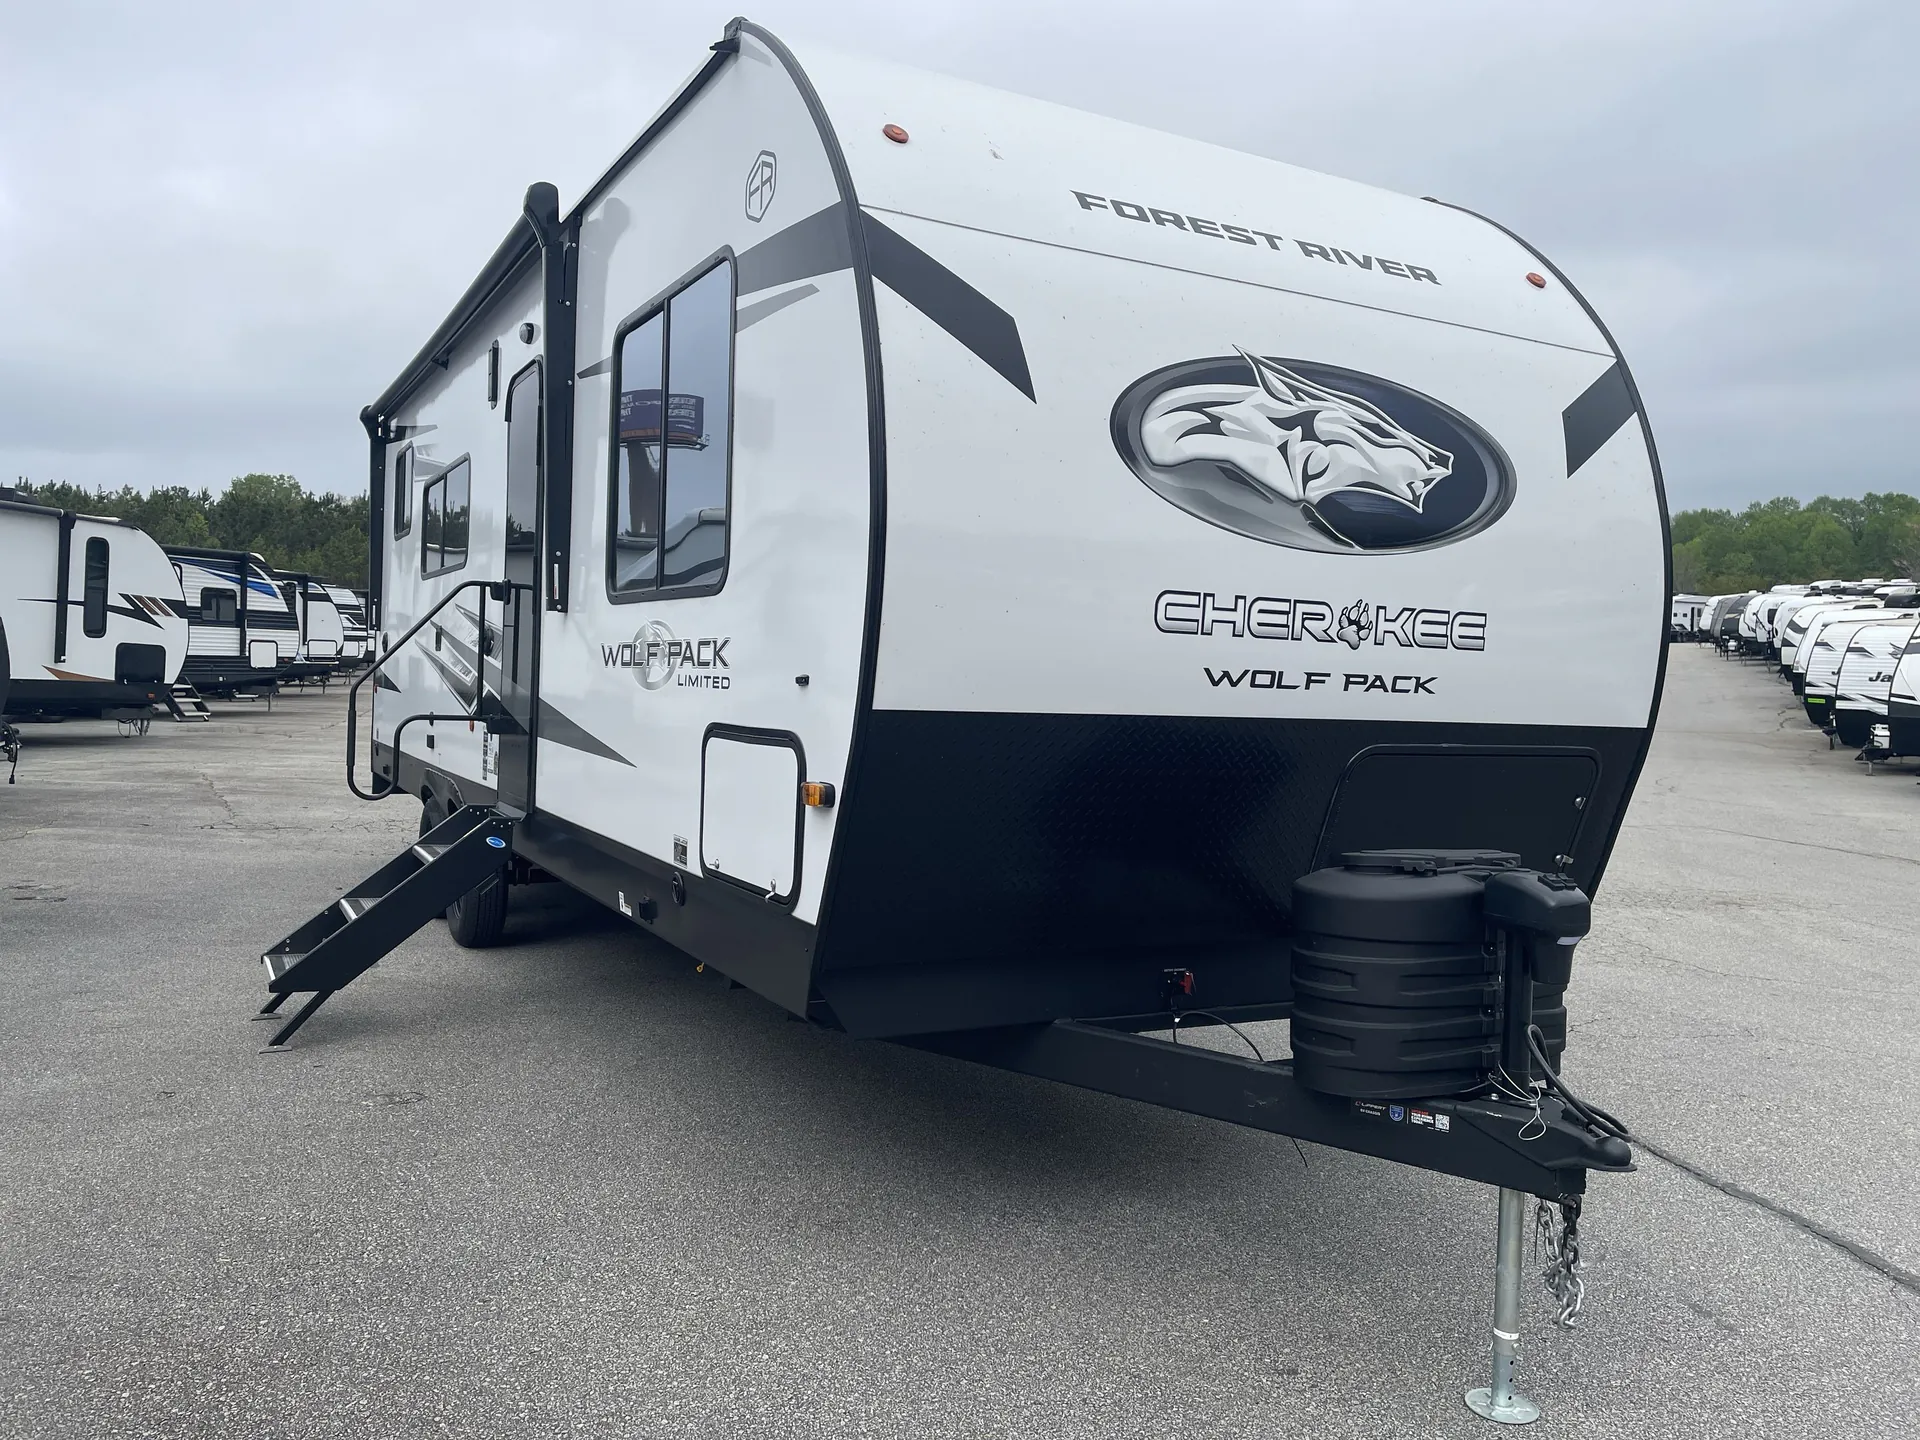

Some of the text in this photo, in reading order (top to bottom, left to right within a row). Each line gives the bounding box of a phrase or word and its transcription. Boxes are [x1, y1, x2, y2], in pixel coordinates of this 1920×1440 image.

[1069, 190, 1442, 286] FOREST RIVER
[601, 637, 731, 669] WOLF PACK
[677, 674, 731, 690] LIMITED
[1203, 667, 1439, 695] WOLF PACK
[1868, 671, 1893, 682] Ja
